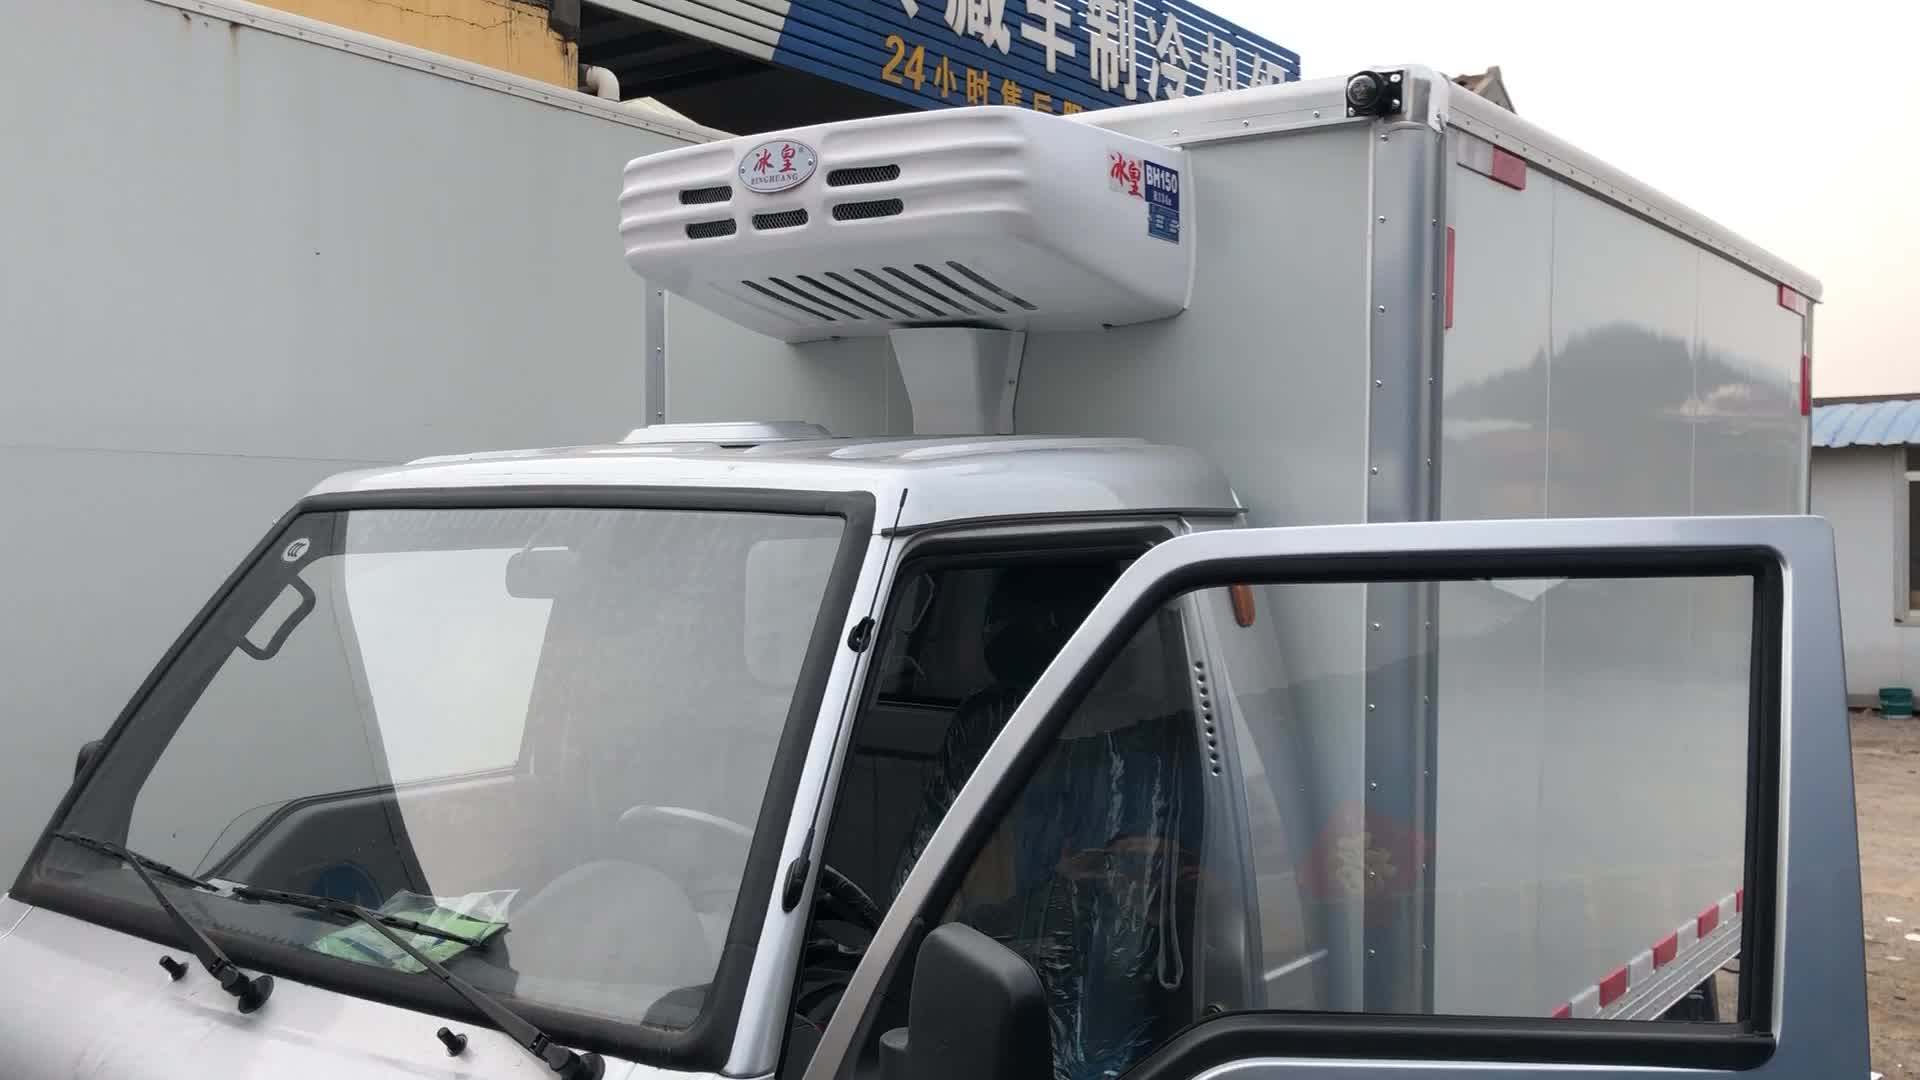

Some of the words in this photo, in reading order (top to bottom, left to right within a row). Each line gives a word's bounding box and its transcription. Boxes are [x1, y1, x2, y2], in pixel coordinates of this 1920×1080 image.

[753, 144, 797, 175] 冰皇
[1110, 151, 1144, 198] 冰皇
[1146, 164, 1178, 193] BH150
